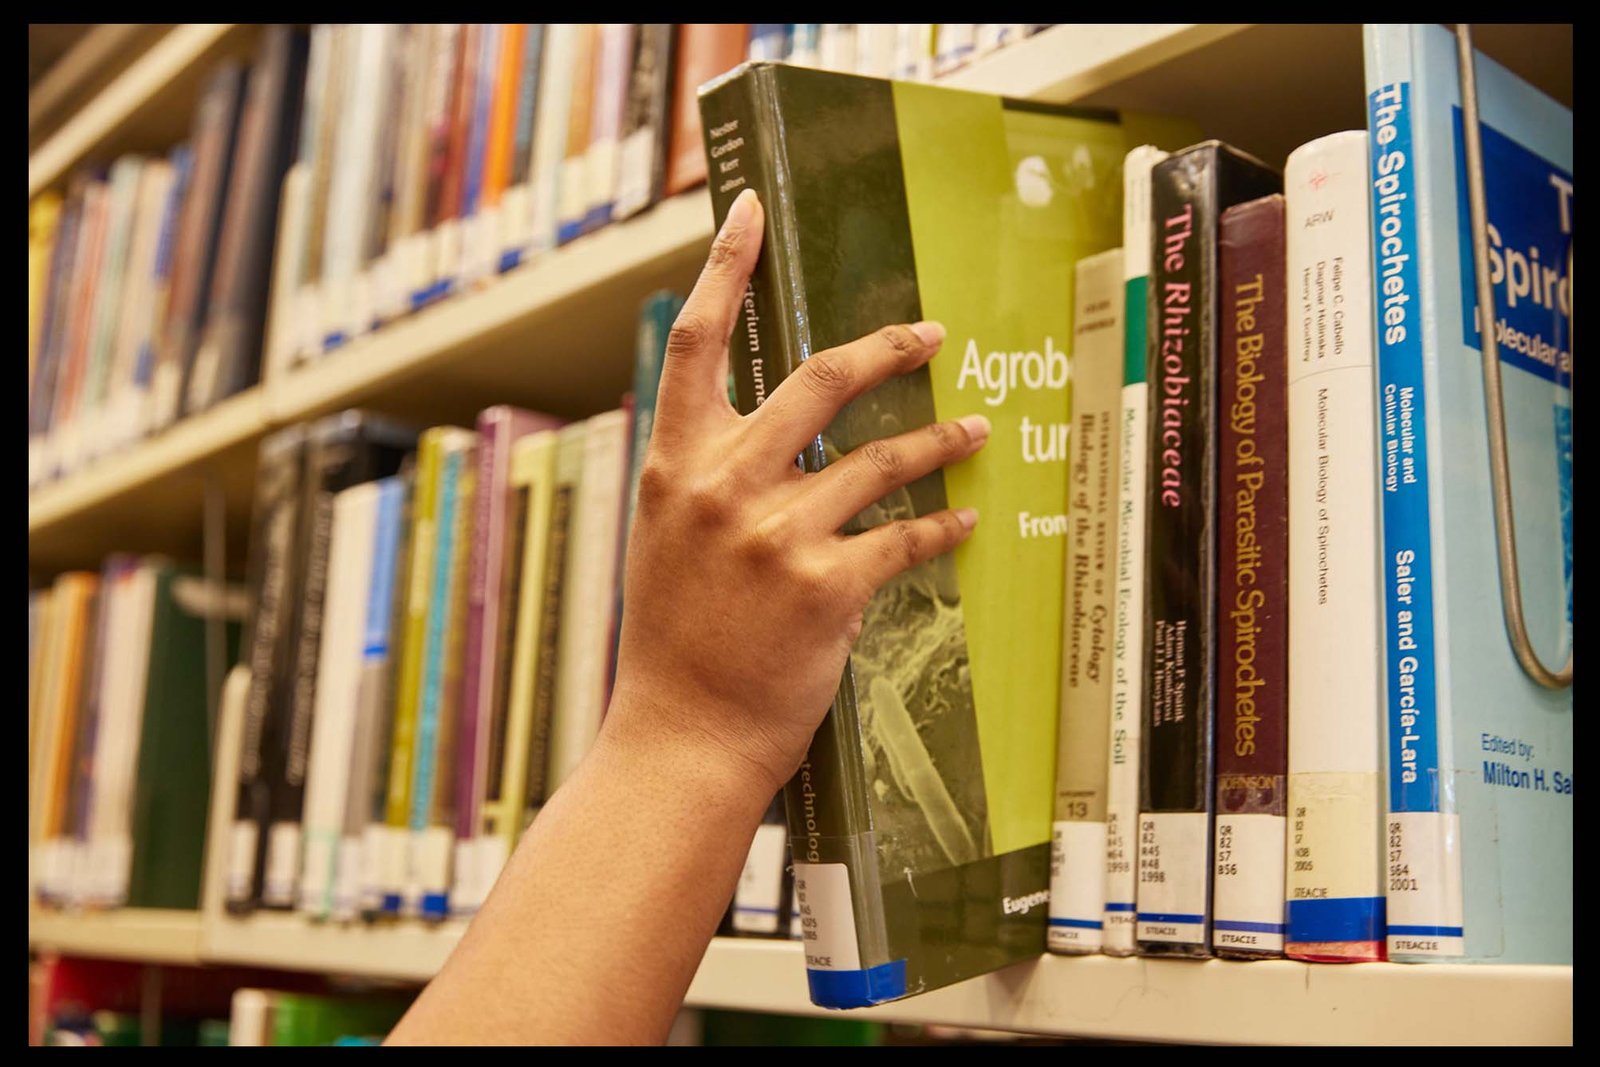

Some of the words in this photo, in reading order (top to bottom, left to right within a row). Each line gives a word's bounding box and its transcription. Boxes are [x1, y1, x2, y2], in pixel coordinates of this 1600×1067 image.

[1374, 83, 1403, 146] The
[711, 136, 745, 159] Gordon
[719, 158, 740, 173] Kerr
[1303, 208, 1335, 229] ARW
[1164, 203, 1193, 273] The
[1374, 150, 1411, 346] Spirochetes
[1315, 260, 1327, 305] Dagmar
[1332, 256, 1344, 292] Felipe
[1235, 273, 1264, 332] The
[1316, 308, 1327, 359] Hulinska
[1333, 310, 1345, 356] Cabello
[751, 357, 767, 406] tume
[956, 335, 1073, 407] Agrob
[1230, 334, 1265, 434] Biology
[1161, 282, 1192, 508] Rhizobiaceae
[1384, 383, 1397, 437] Cellular
[1316, 387, 1329, 451] Molecular
[1399, 385, 1417, 454] Molecular
[1074, 414, 1095, 485] Biology
[1122, 408, 1135, 492] Molecular
[1235, 439, 1265, 469] of
[1385, 438, 1399, 493] Biology
[1315, 454, 1330, 504] Biology
[1402, 456, 1418, 485] and
[1072, 491, 1093, 514] of
[1317, 508, 1329, 522] of
[1074, 516, 1092, 547] the
[1119, 499, 1133, 581] Microbial
[1236, 471, 1265, 586] Parasitic
[1316, 524, 1330, 606] Spirochetes
[1395, 549, 1416, 605] Saier
[1115, 586, 1131, 660] Ecology
[1155, 619, 1166, 646] Paul
[1397, 610, 1418, 651] and
[1086, 603, 1108, 685] Cytology
[1165, 624, 1176, 659] Adam
[1175, 619, 1187, 666] Herman
[1115, 664, 1129, 686] of
[1230, 589, 1266, 757] Spirochetes
[1114, 690, 1128, 721] the
[1174, 682, 1187, 723] Spaink
[1113, 726, 1127, 765] Soil
[1480, 732, 1518, 756] Edited
[1219, 775, 1277, 791] JOHNSON
[1482, 760, 1530, 790] Milton
[1533, 769, 1551, 793] H.
[1552, 773, 1573, 795] Sa
[1066, 801, 1088, 818] 13
[1142, 821, 1155, 832] QR
[1142, 833, 1155, 845] 82
[1219, 825, 1233, 837] QR
[1219, 837, 1232, 849] 82
[1389, 822, 1402, 835] QR
[1389, 836, 1401, 848] 82
[1141, 871, 1166, 884] 1998
[1294, 887, 1328, 899] STEACIE
[1389, 878, 1419, 892] 2001
[1110, 915, 1137, 925] STEAC
[1145, 926, 1178, 937] STEACIE
[1220, 934, 1258, 945] STEACIE
[1394, 940, 1439, 951] STEACIE
